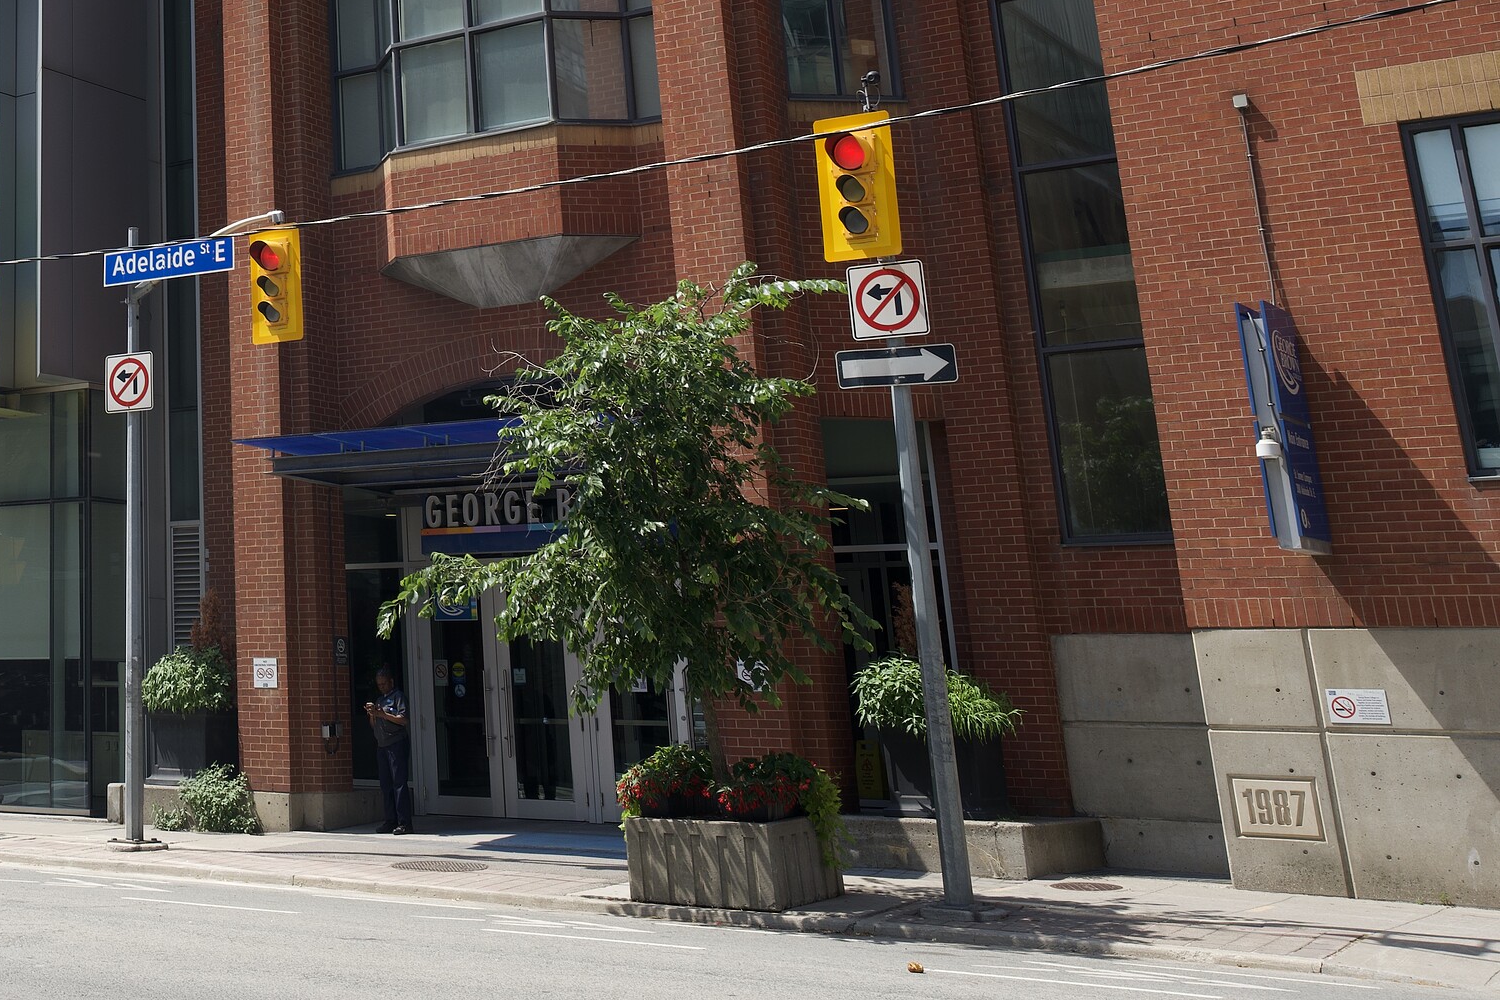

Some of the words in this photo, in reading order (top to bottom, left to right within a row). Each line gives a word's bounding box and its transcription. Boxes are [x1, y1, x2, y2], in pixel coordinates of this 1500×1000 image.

[112, 246, 195, 276] Adelaide
[200, 243, 210, 254] St
[215, 240, 225, 262] E
[425, 490, 540, 528] GEORGE
[1242, 788, 1306, 827] 1987
